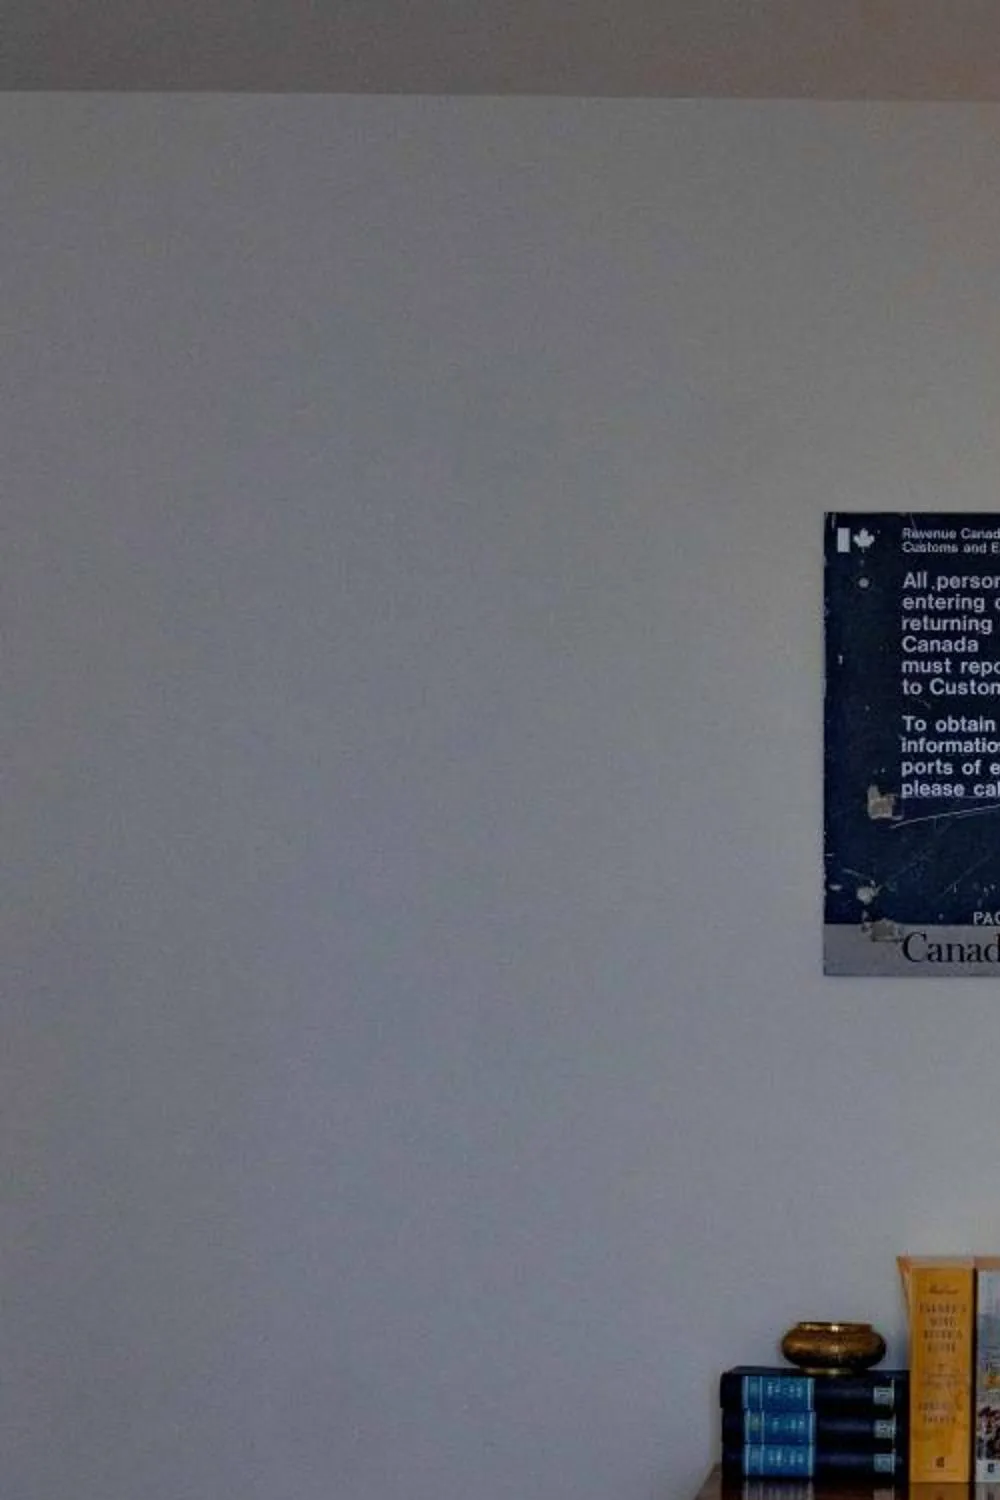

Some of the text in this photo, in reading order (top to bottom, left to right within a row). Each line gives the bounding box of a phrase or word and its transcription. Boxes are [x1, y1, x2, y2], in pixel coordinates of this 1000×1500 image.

[902, 527, 957, 540] Revenue
[901, 542, 966, 554] Customs
[966, 542, 987, 554] and
[903, 571, 928, 589] All
[902, 592, 986, 615] entering
[901, 613, 993, 635] returning
[901, 636, 979, 653] Canada
[901, 658, 952, 674] must
[903, 679, 923, 696] to
[902, 715, 996, 733] To obtain
[900, 760, 953, 778] ports
[961, 758, 982, 776] of
[900, 781, 966, 800] please
